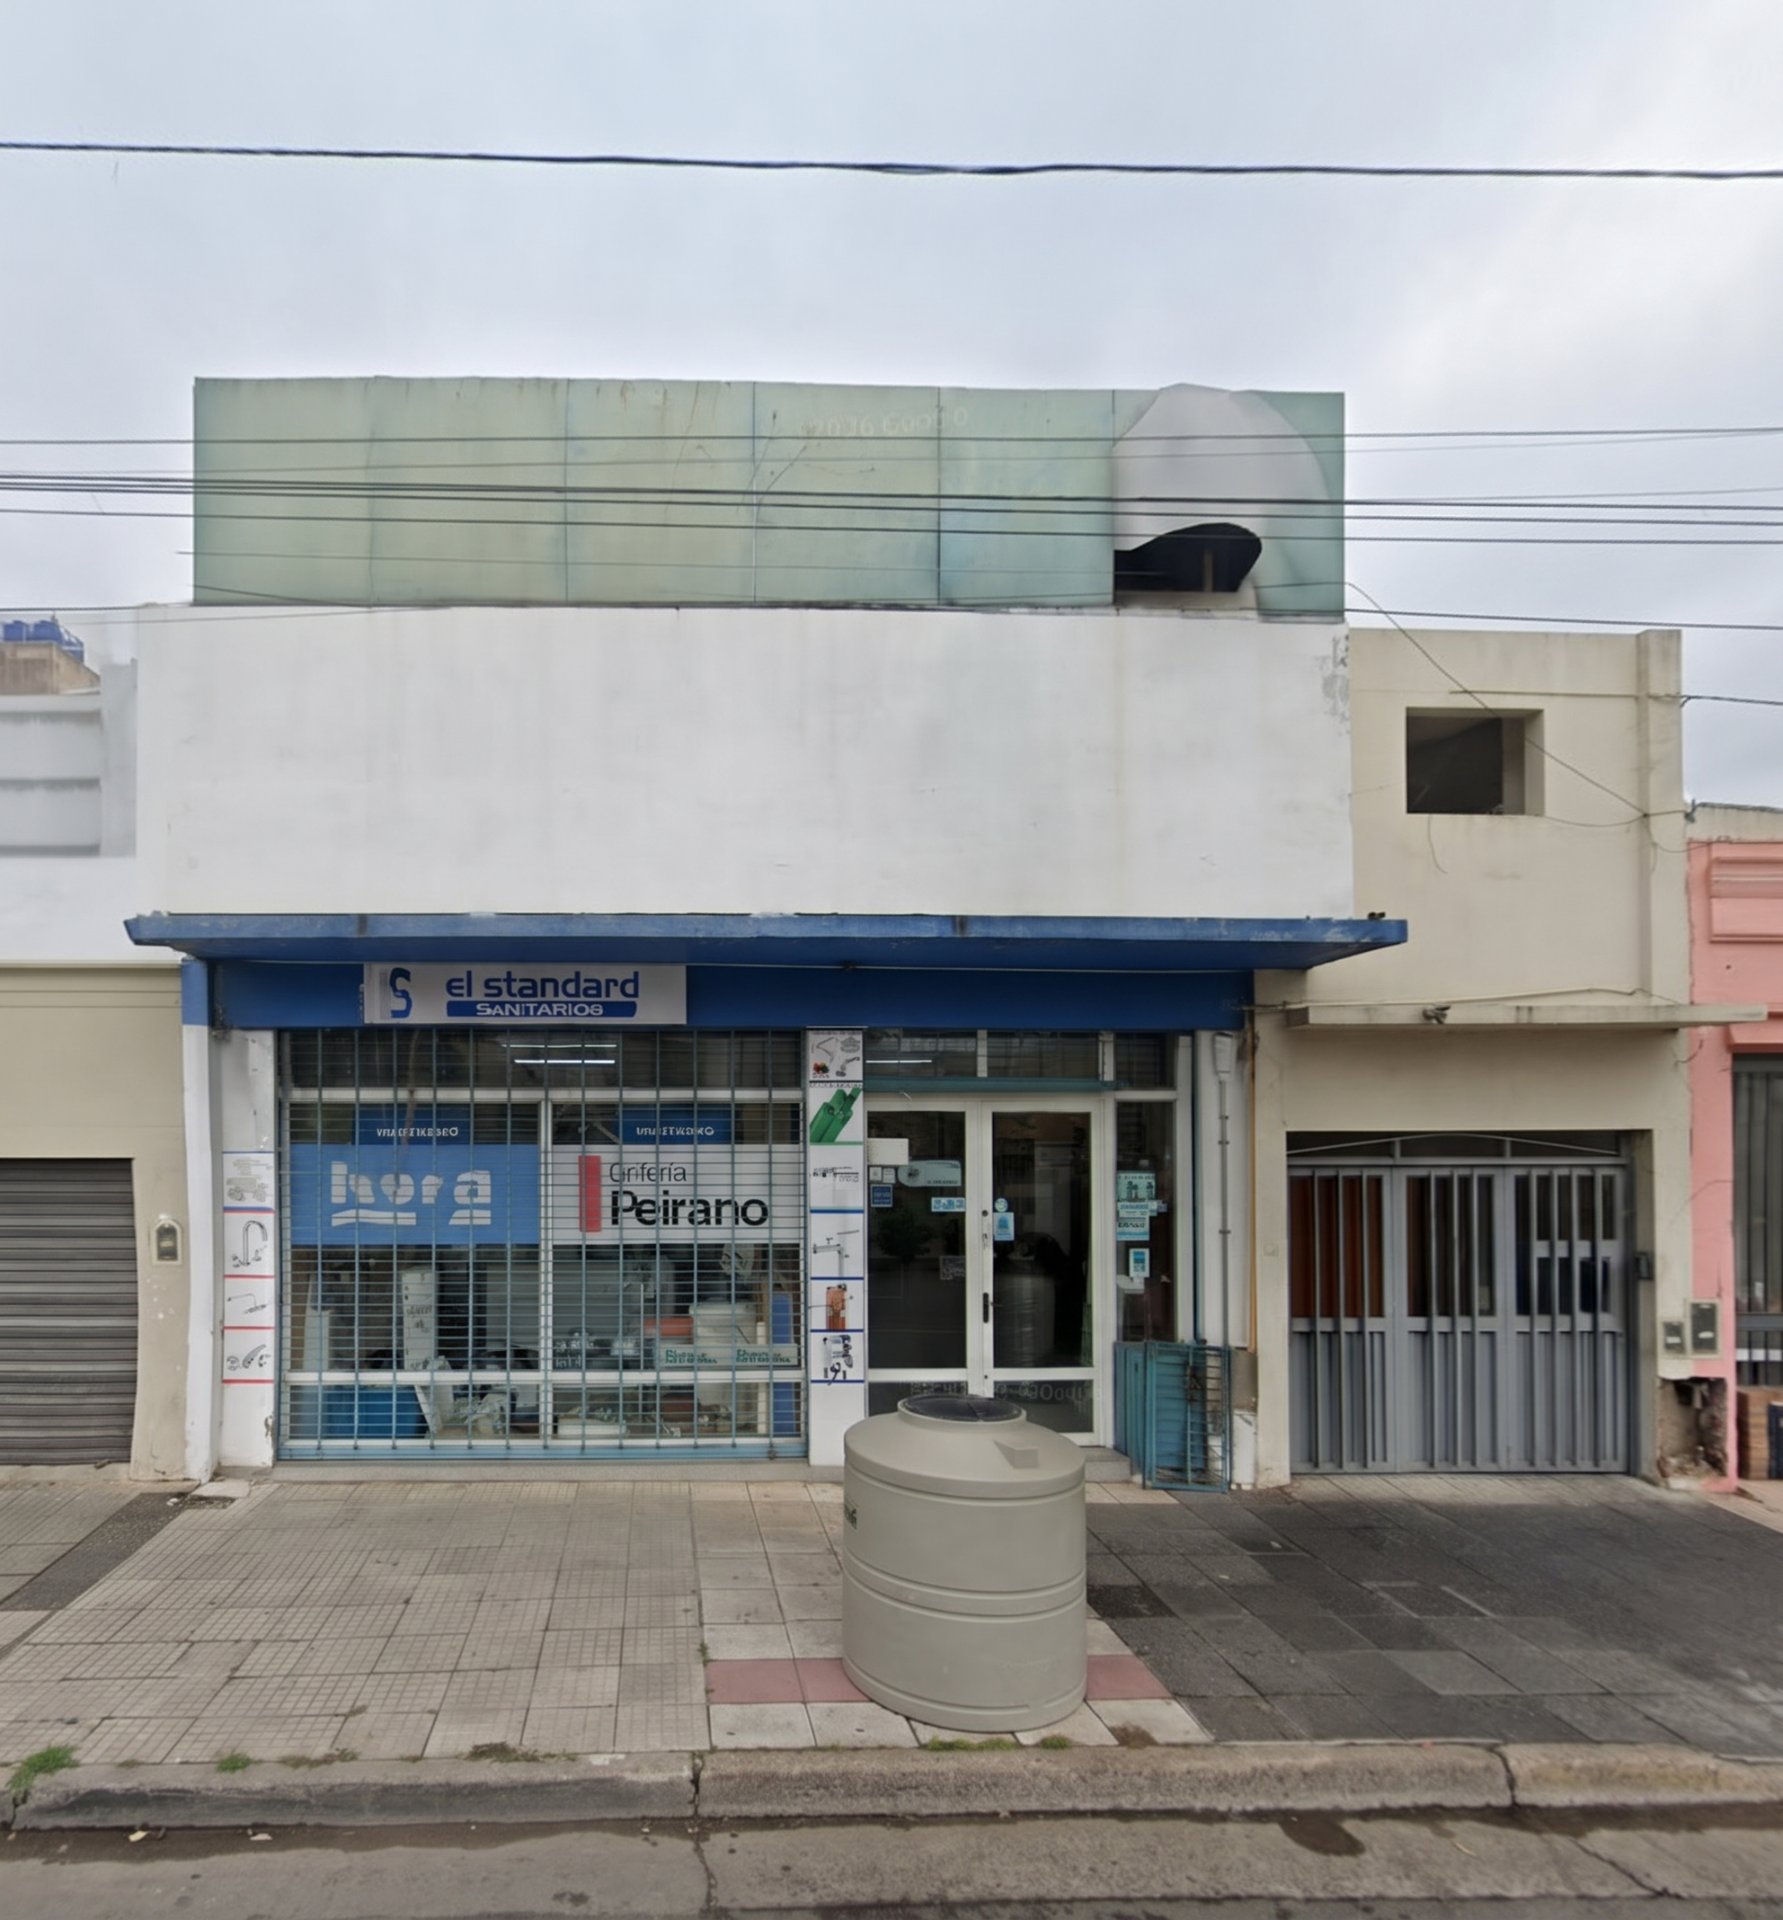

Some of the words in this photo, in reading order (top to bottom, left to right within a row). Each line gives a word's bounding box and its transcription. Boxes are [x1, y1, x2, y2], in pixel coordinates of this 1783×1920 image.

[445, 970, 473, 998] el
[483, 969, 641, 998] standard
[475, 1002, 605, 1017] SANITARIOS
[608, 1162, 688, 1184] Grifería
[610, 1190, 769, 1227] Peirano
